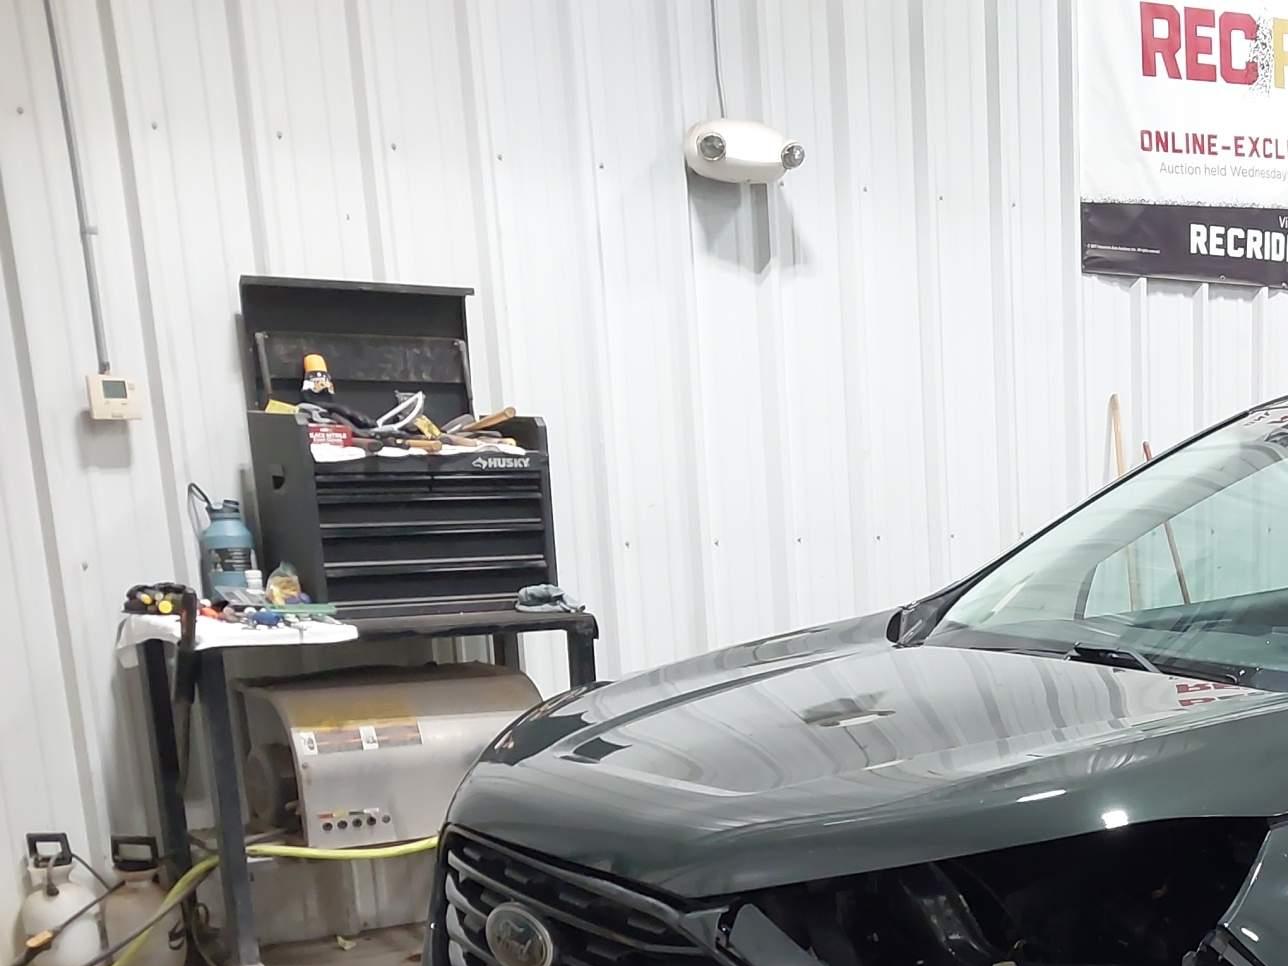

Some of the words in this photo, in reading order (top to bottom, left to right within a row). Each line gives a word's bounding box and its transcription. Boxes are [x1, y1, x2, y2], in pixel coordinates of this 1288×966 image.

[1159, 161, 1202, 176] Auction
[1204, 164, 1227, 177] held
[487, 458, 530, 468] HUSKY
